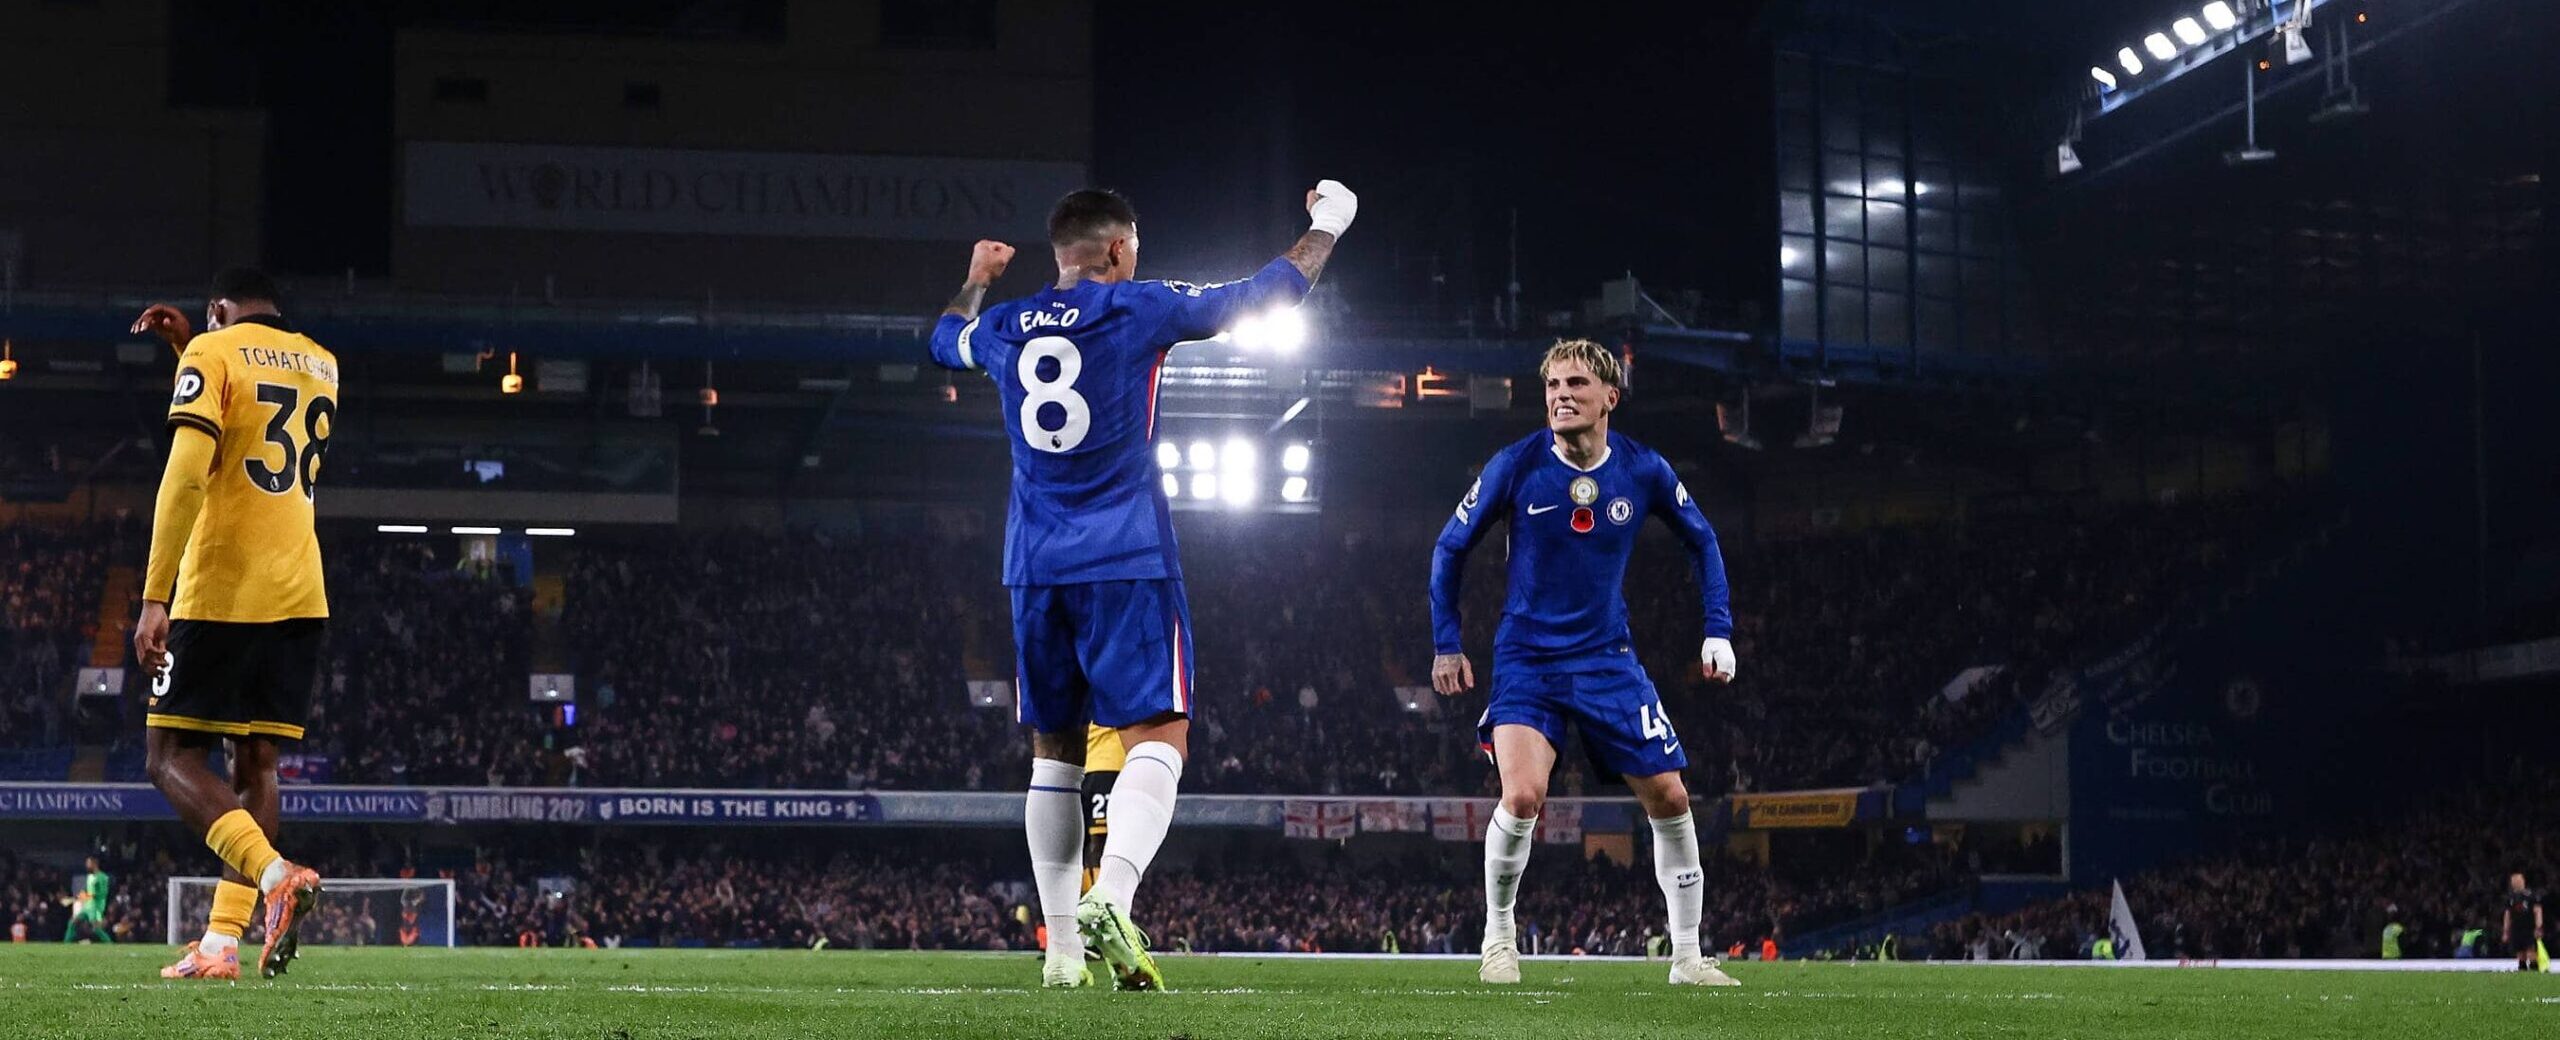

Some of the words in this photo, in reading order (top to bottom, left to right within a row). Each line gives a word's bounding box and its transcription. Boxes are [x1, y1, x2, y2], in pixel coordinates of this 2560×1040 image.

[692, 168, 1019, 226] CHAMPIONS
[1017, 335, 1091, 453] 8
[244, 381, 336, 504] 38
[450, 795, 545, 821] TAMBLING
[619, 797, 685, 817] BORN
[692, 799, 715, 817] IS
[722, 799, 767, 817] THE
[774, 799, 832, 817] KING
